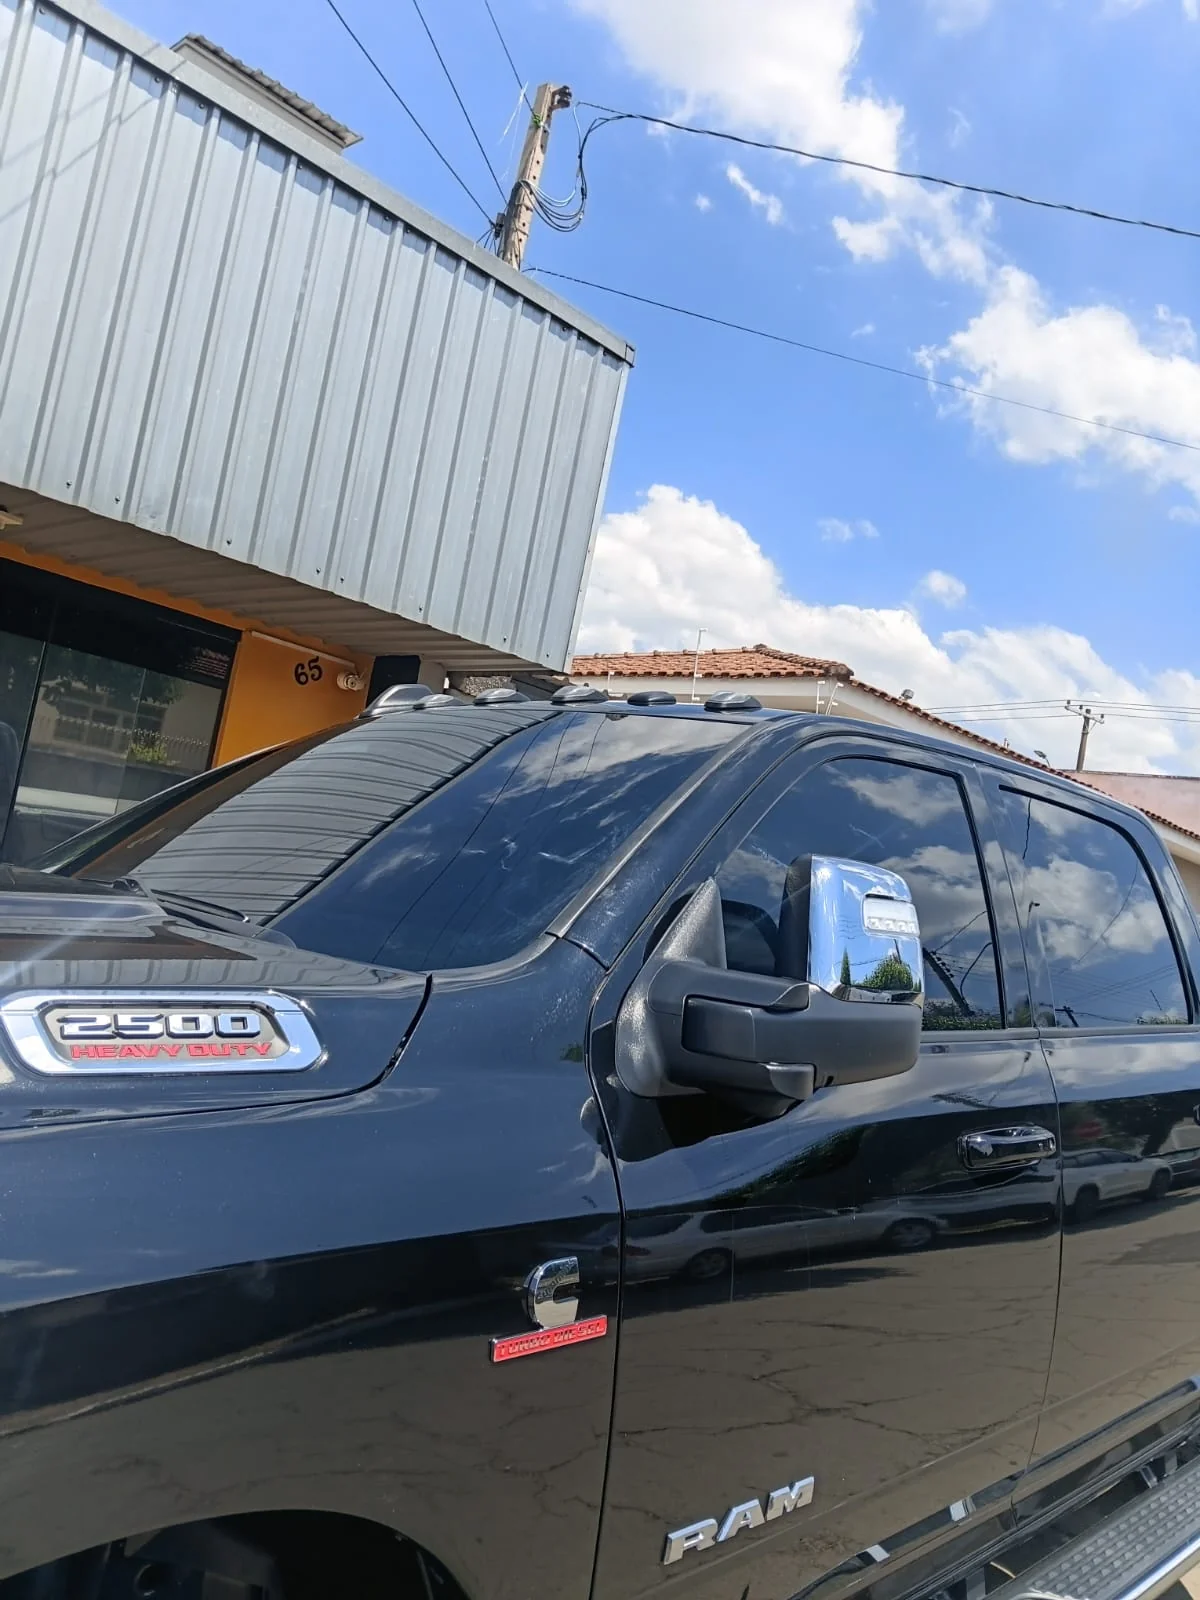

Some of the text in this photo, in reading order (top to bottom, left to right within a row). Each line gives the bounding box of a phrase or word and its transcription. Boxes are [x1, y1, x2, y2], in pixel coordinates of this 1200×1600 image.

[294, 656, 323, 686] 65
[57, 1013, 261, 1040] 2500
[71, 1043, 272, 1059] HEAVY DUTY
[498, 1322, 604, 1356] TURBO DIESEL
[662, 1476, 815, 1566] RAM
